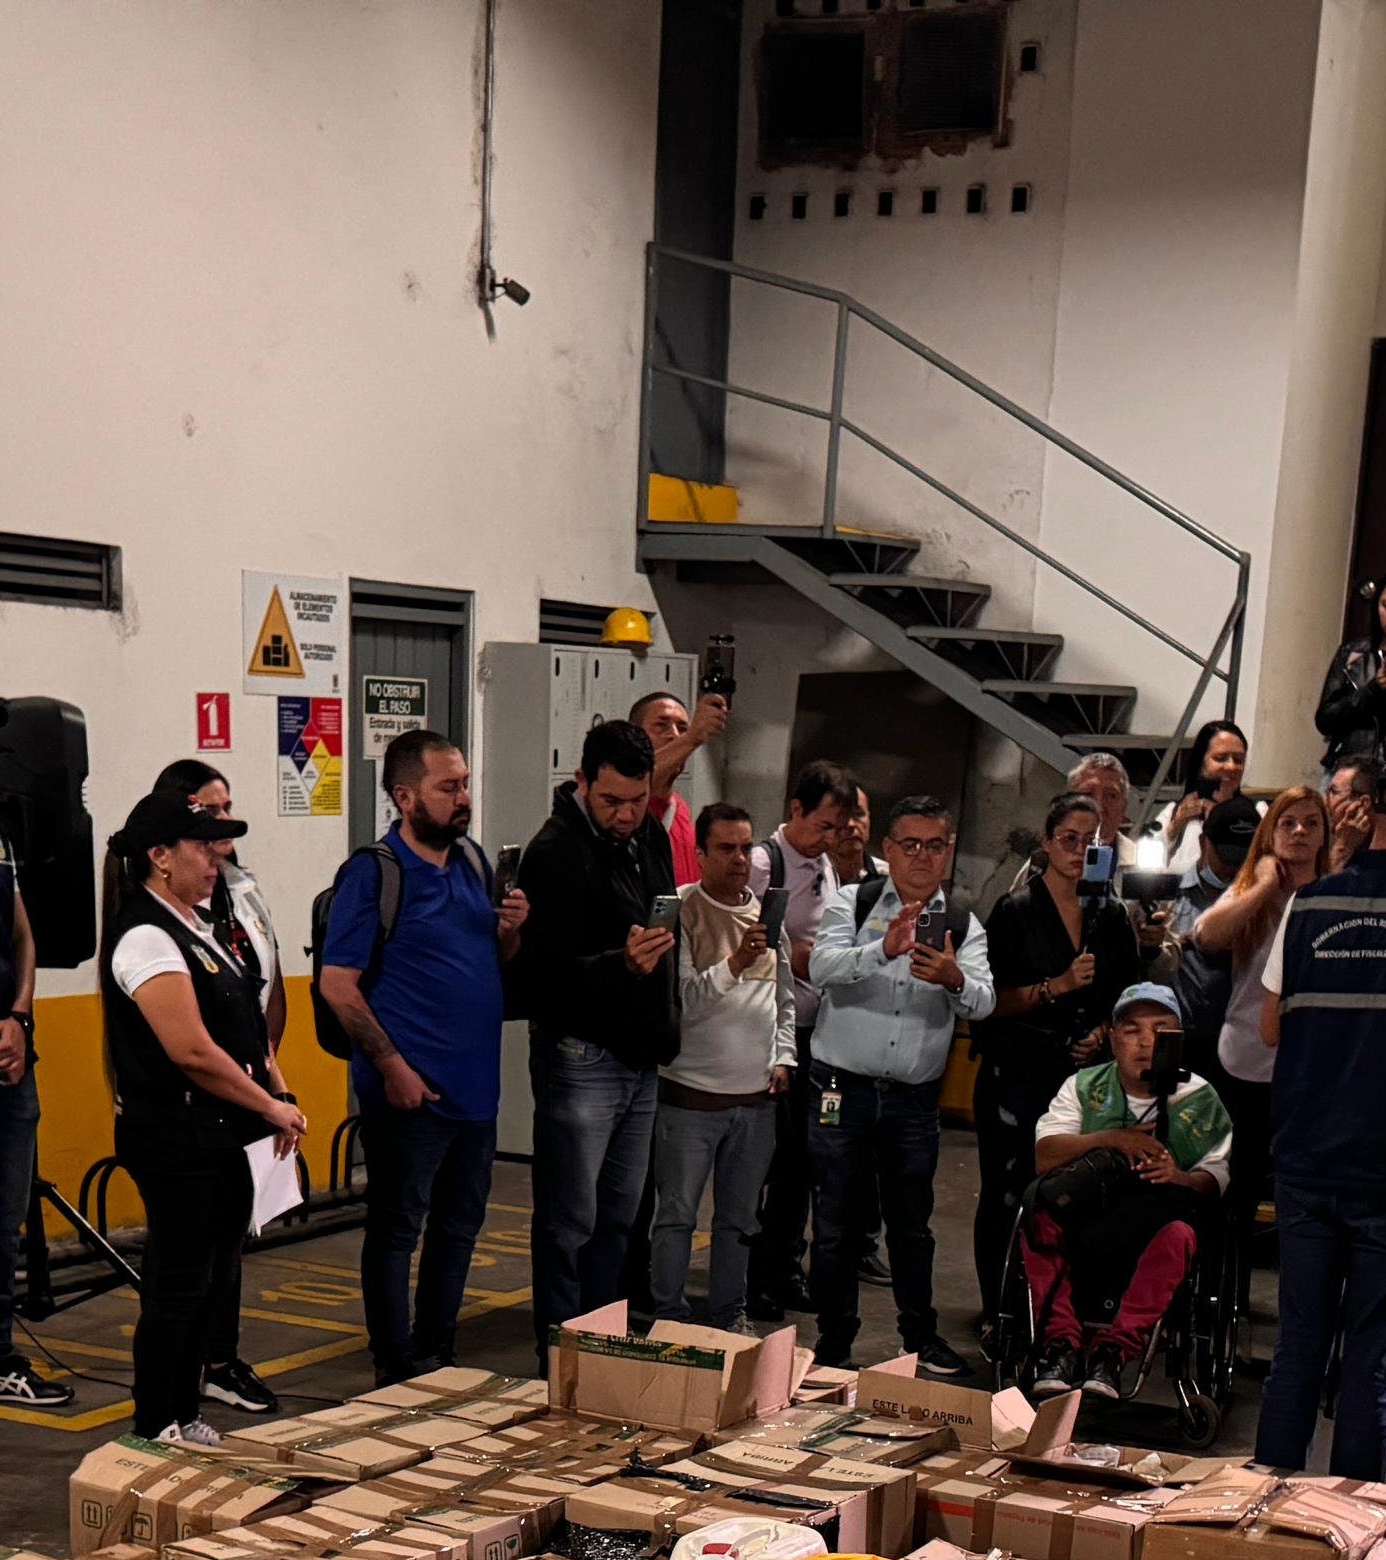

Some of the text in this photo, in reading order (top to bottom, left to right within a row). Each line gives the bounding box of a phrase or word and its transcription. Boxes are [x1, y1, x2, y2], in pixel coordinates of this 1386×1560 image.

[369, 683, 421, 699] NO OBSTRUIR
[379, 700, 411, 714] EL PASO
[369, 717, 395, 729] Entrada
[1363, 916, 1377, 927] DEL
[872, 1399, 973, 1425] ESTE LAO ARRIBA
